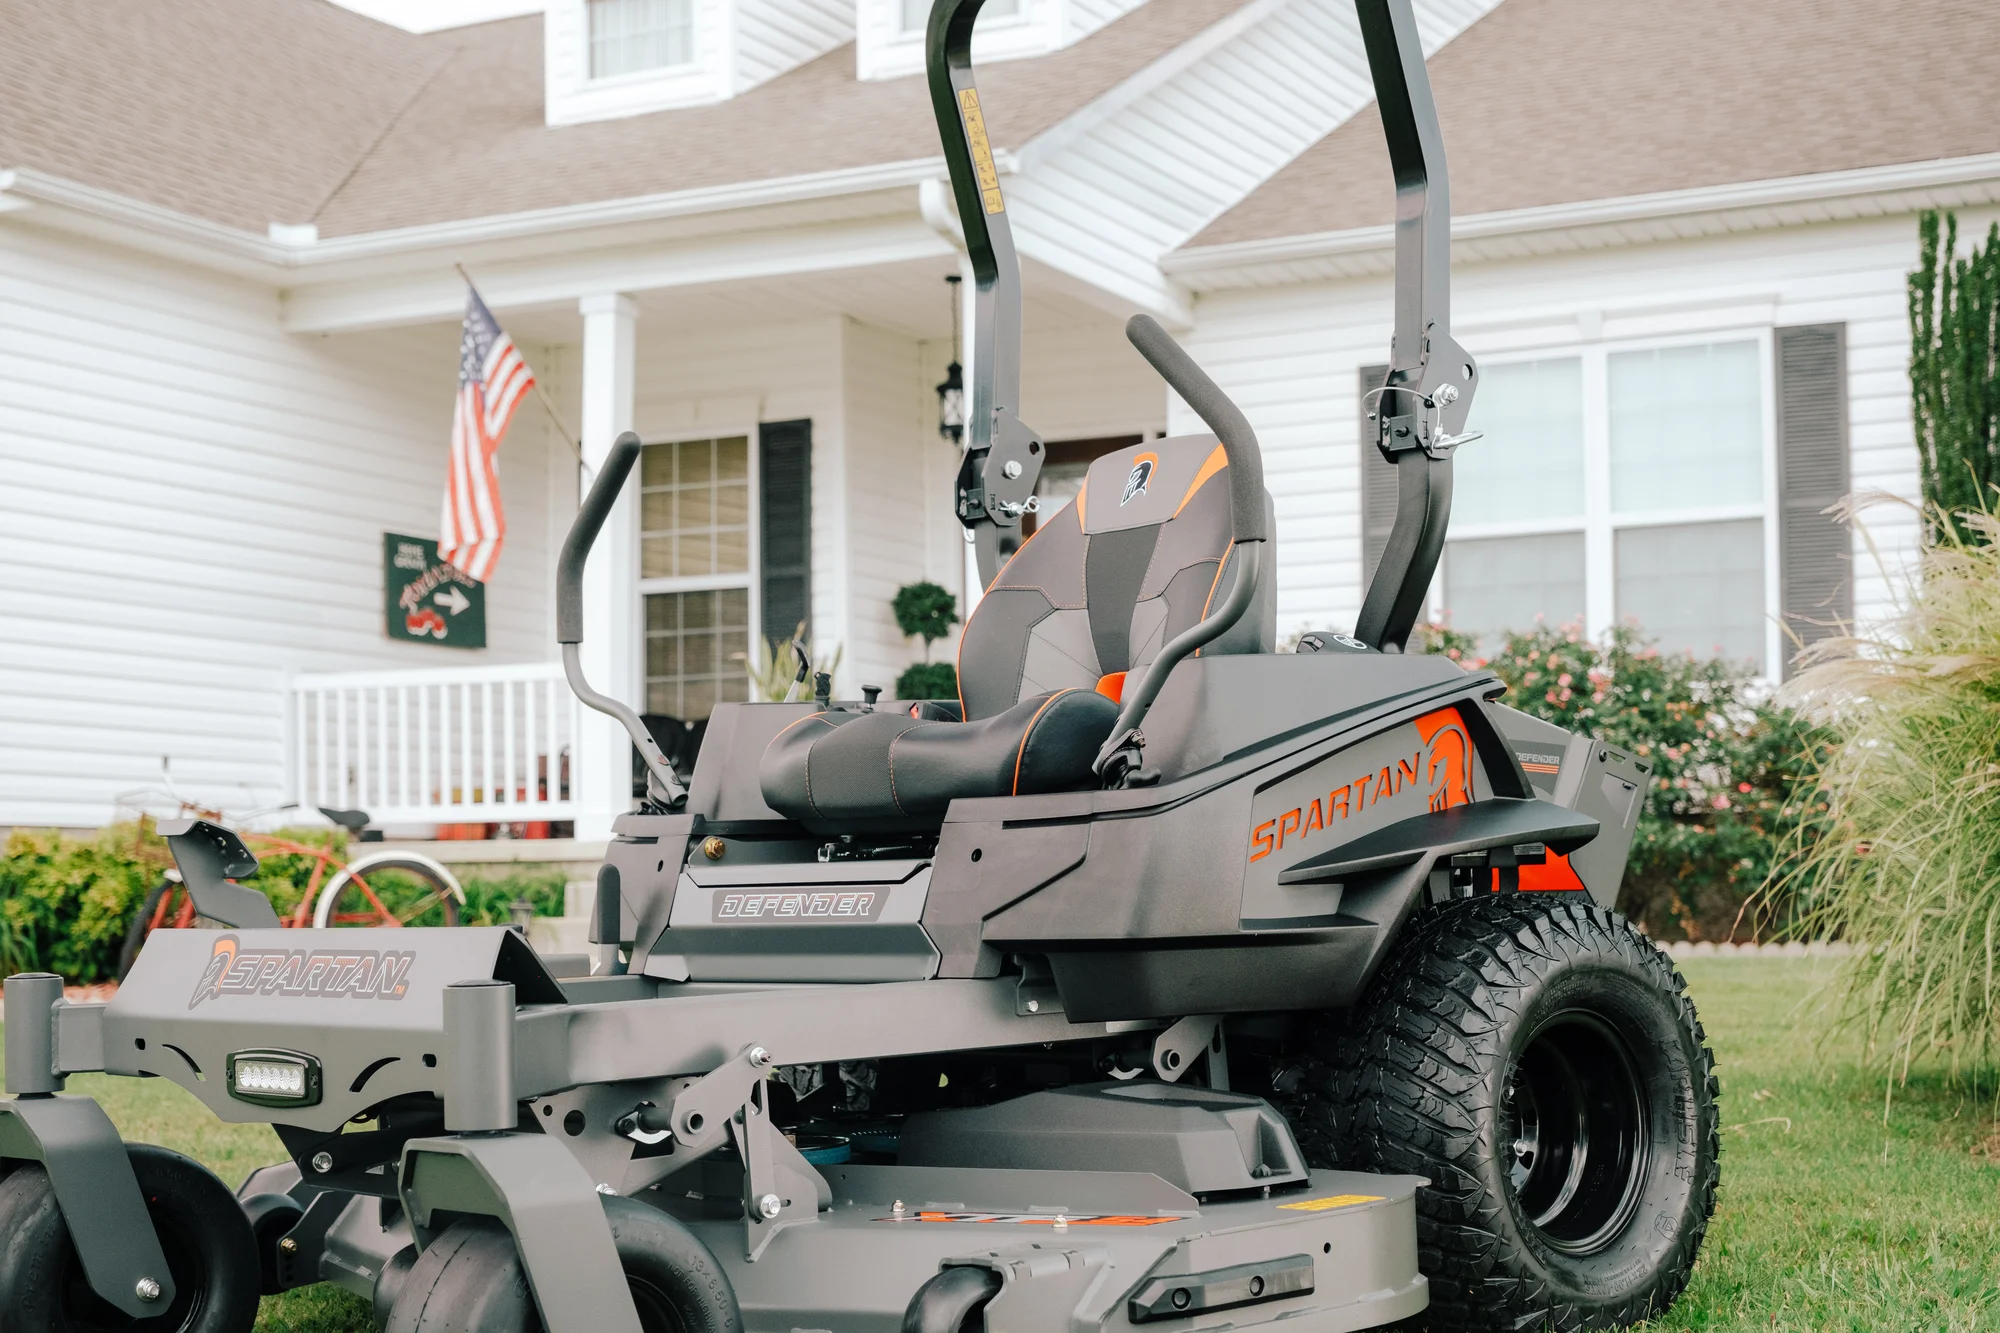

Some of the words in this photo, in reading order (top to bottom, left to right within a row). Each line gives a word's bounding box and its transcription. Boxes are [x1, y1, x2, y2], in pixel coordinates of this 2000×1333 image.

[1515, 752, 1560, 765] DEFENDER
[1250, 751, 1420, 863] SPARTAN
[718, 892, 875, 917] DEFENDER
[221, 954, 411, 993] SPARTAN
[667, 1262, 685, 1279] NOT
[683, 1276, 698, 1295] FOR
